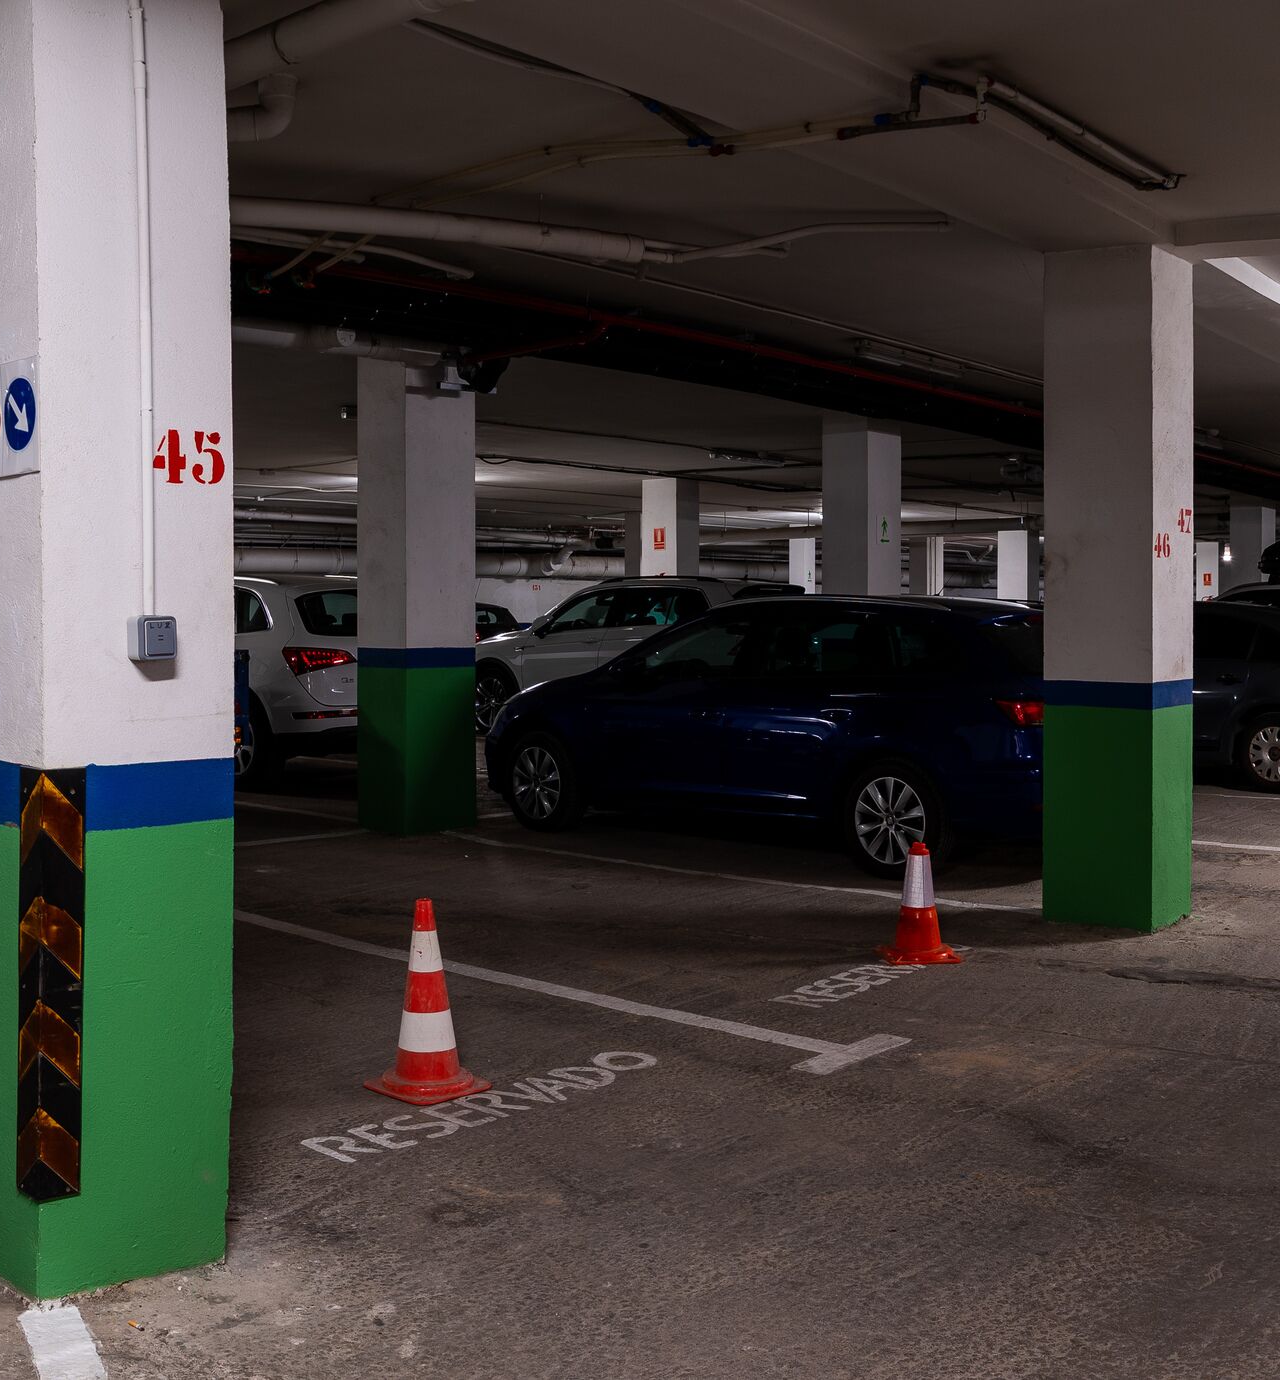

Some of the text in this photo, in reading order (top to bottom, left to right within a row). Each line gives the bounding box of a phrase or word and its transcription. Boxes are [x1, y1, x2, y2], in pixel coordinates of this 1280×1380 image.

[153, 429, 225, 484] 45
[1154, 533, 1170, 558] 46
[1178, 508, 1192, 533] 47
[768, 943, 976, 1008] RESERV
[300, 1051, 657, 1162] RESERVADO
